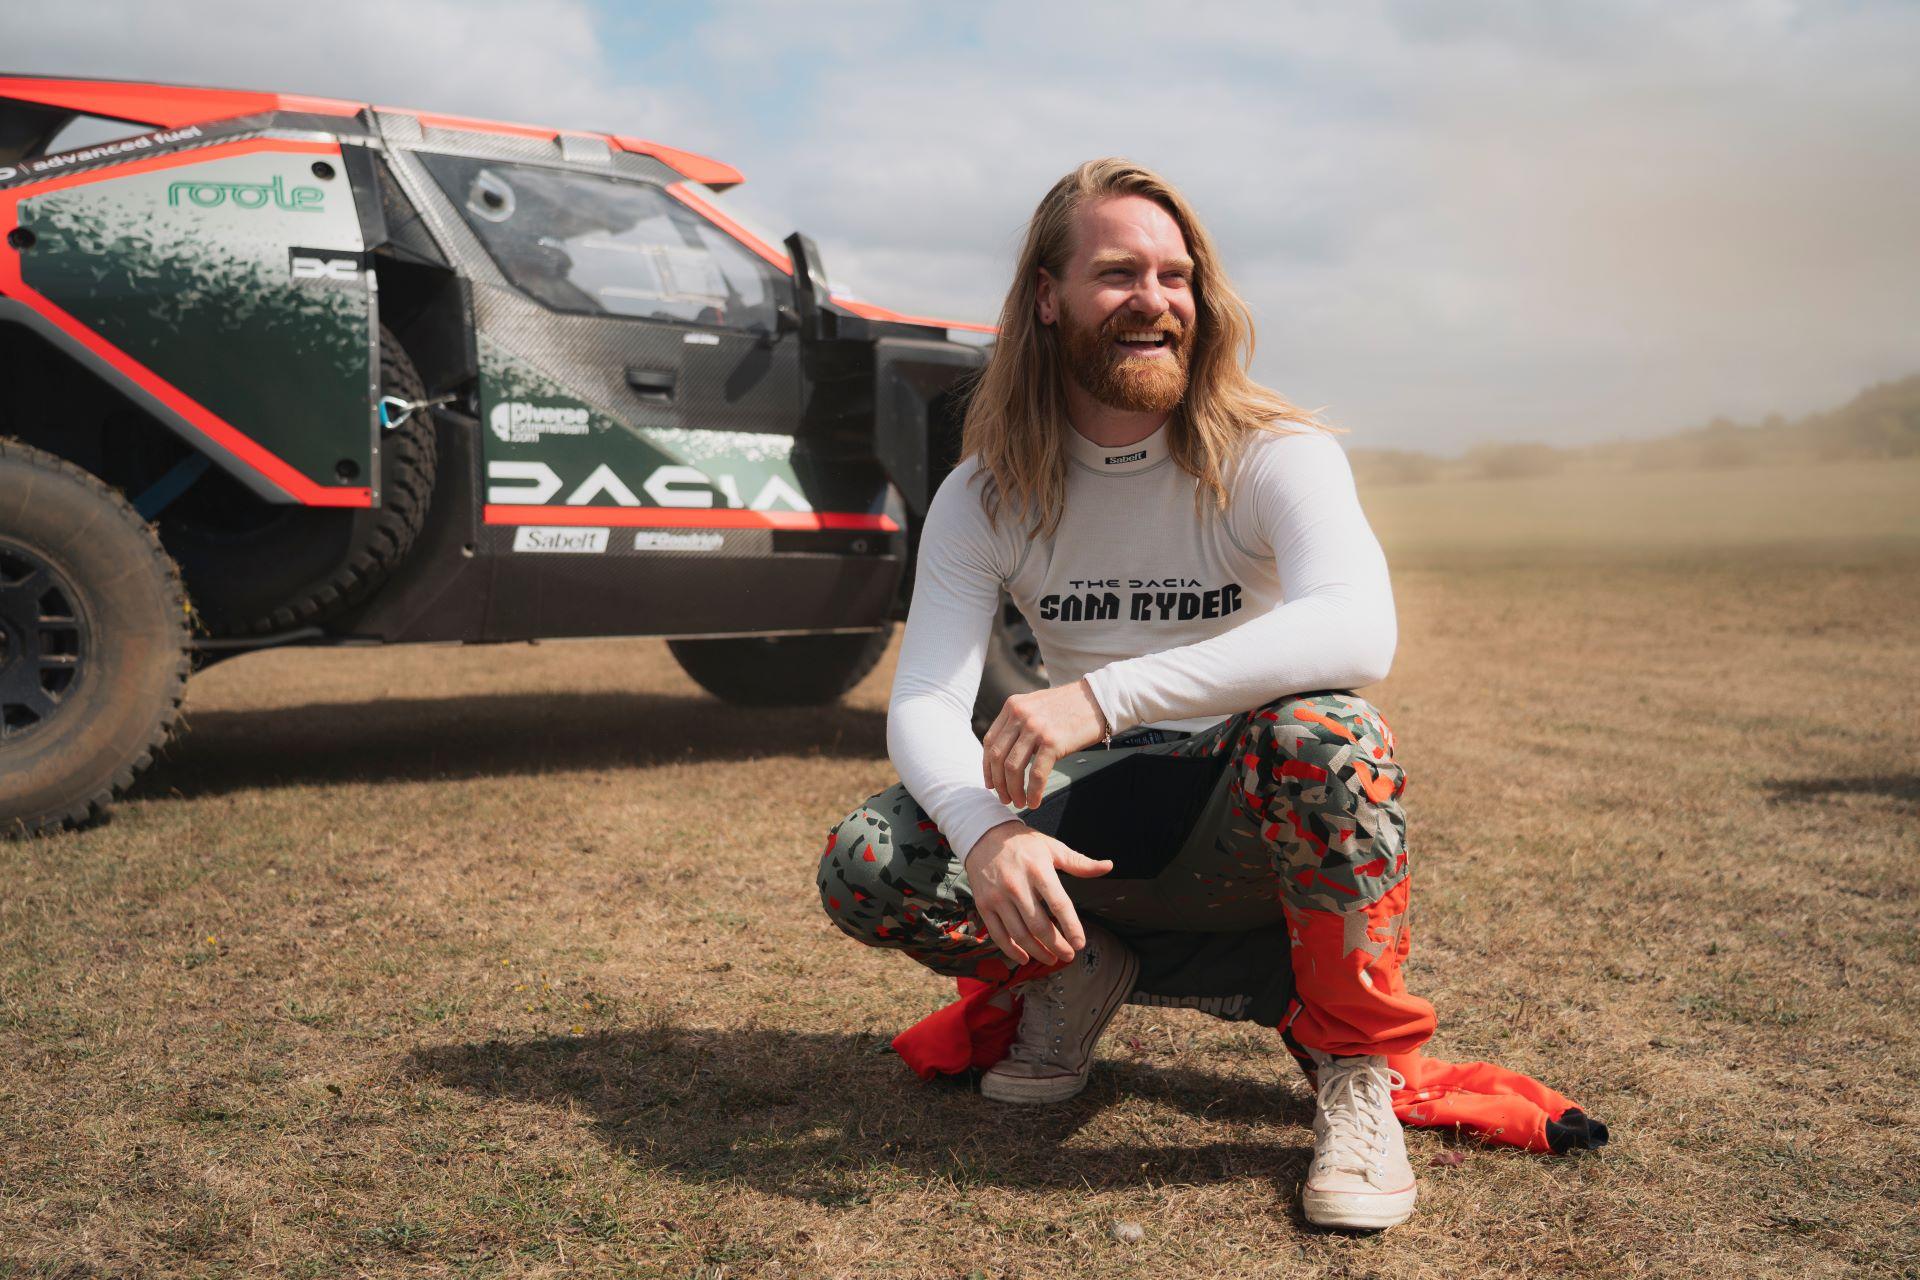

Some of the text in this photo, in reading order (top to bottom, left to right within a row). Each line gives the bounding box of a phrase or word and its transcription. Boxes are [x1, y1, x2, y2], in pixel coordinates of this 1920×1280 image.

[32, 125, 202, 172] advanced fuel
[487, 460, 815, 513] DACIA
[526, 529, 597, 549] Sabelt
[1039, 583, 1242, 622] SAM RYDER
[1069, 578, 1202, 589] THE DACIA
